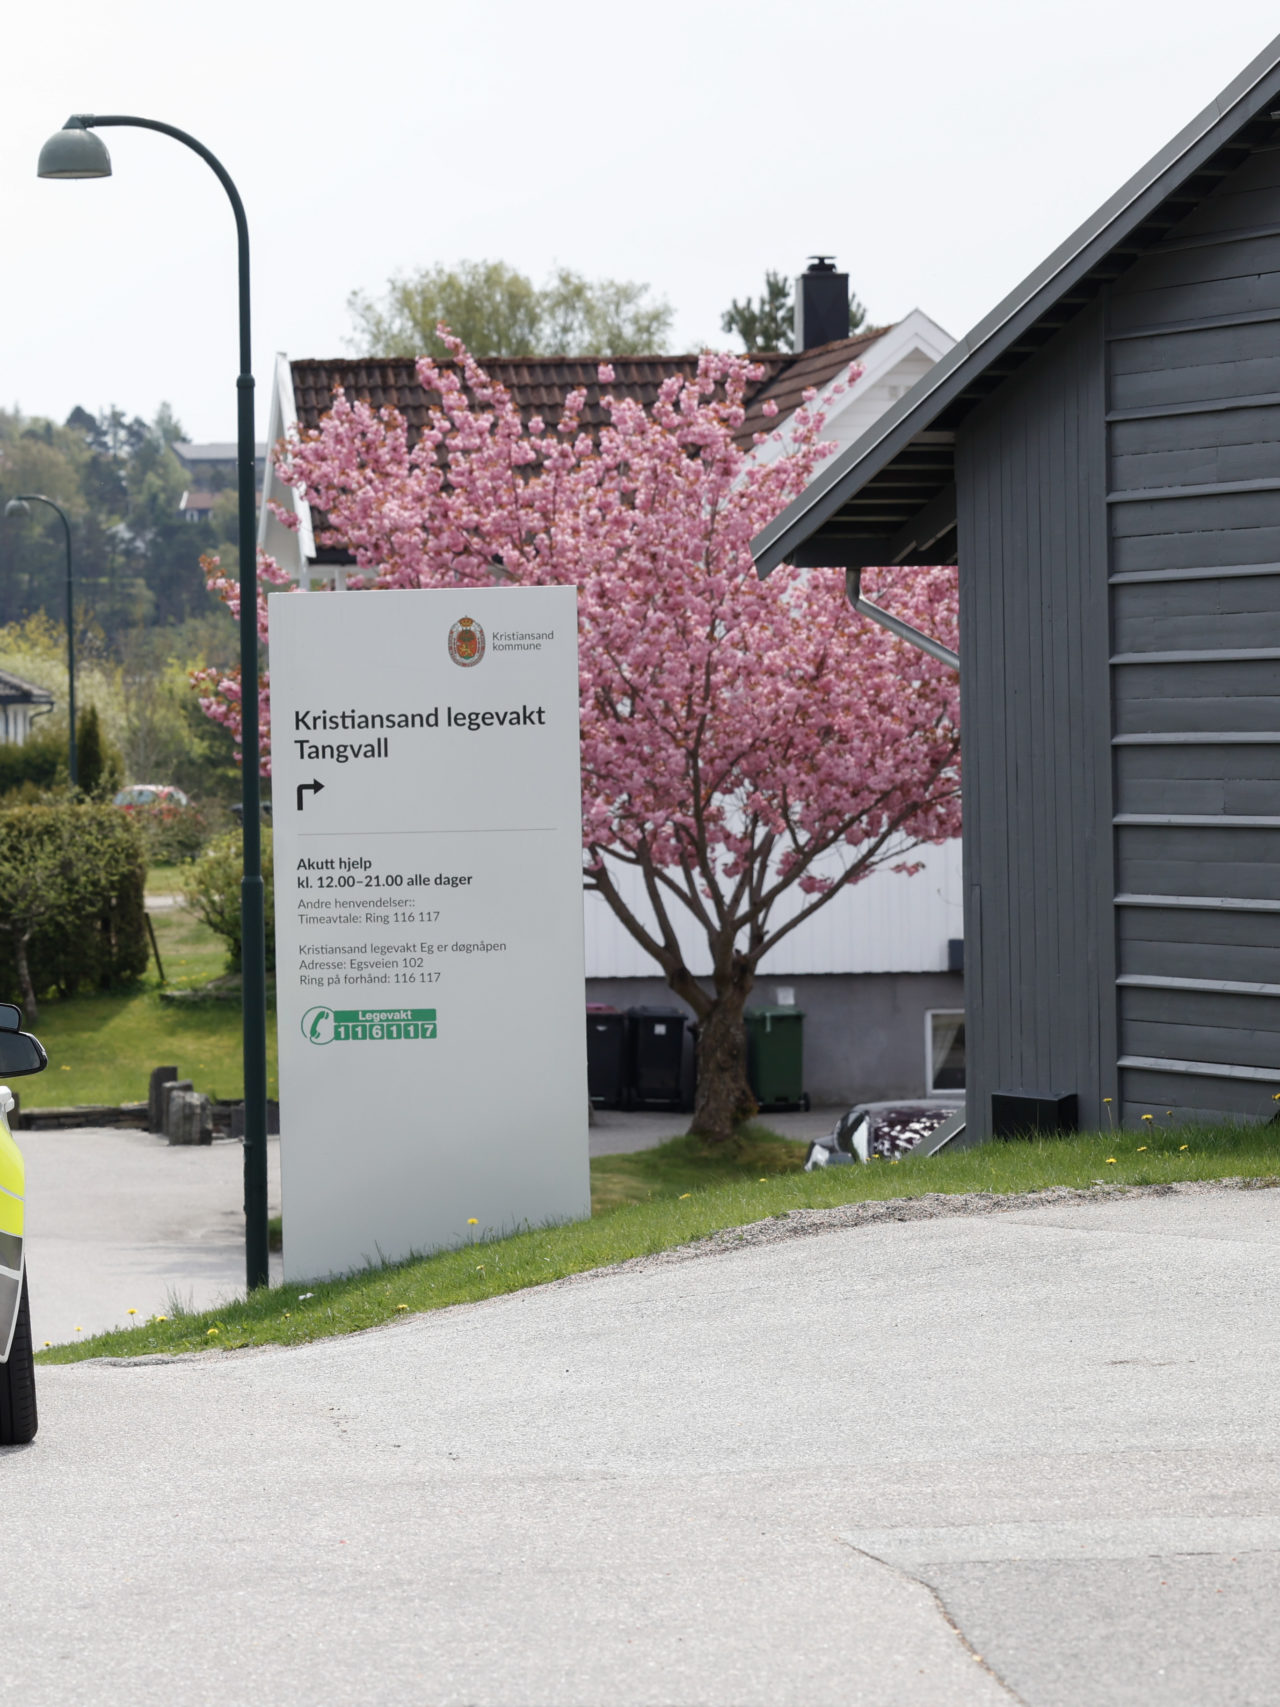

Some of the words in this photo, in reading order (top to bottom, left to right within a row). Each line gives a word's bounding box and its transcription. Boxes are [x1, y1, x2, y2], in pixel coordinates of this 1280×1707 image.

[492, 630, 554, 641] Kristiansand
[492, 641, 542, 651] kommune
[294, 708, 439, 731] Kristiansand
[446, 705, 546, 731] legevakt
[294, 737, 389, 763] Tangvall
[297, 858, 335, 871] Akutt
[339, 857, 372, 872] hjelp
[297, 876, 313, 889] kl.
[407, 873, 431, 887] alle
[434, 873, 473, 888] dager
[298, 898, 332, 909] Andre
[298, 913, 362, 925] Timeavtale:
[365, 912, 390, 925] Ring
[393, 911, 415, 923] 116
[418, 911, 440, 923] 117
[299, 944, 367, 955] Kristiansand
[370, 942, 417, 956] legevakt
[420, 942, 434, 955] Eg
[437, 944, 449, 953] er
[451, 940, 507, 954] døgnåpen
[299, 959, 346, 970] Adresse:
[349, 958, 399, 971] Egsveien
[402, 957, 424, 968] 102
[300, 975, 324, 987] Ring
[327, 974, 341, 987] på
[344, 972, 390, 984] forhånd:
[394, 972, 415, 983] 116
[419, 972, 441, 983] 117
[358, 1010, 412, 1022] Legevakt
